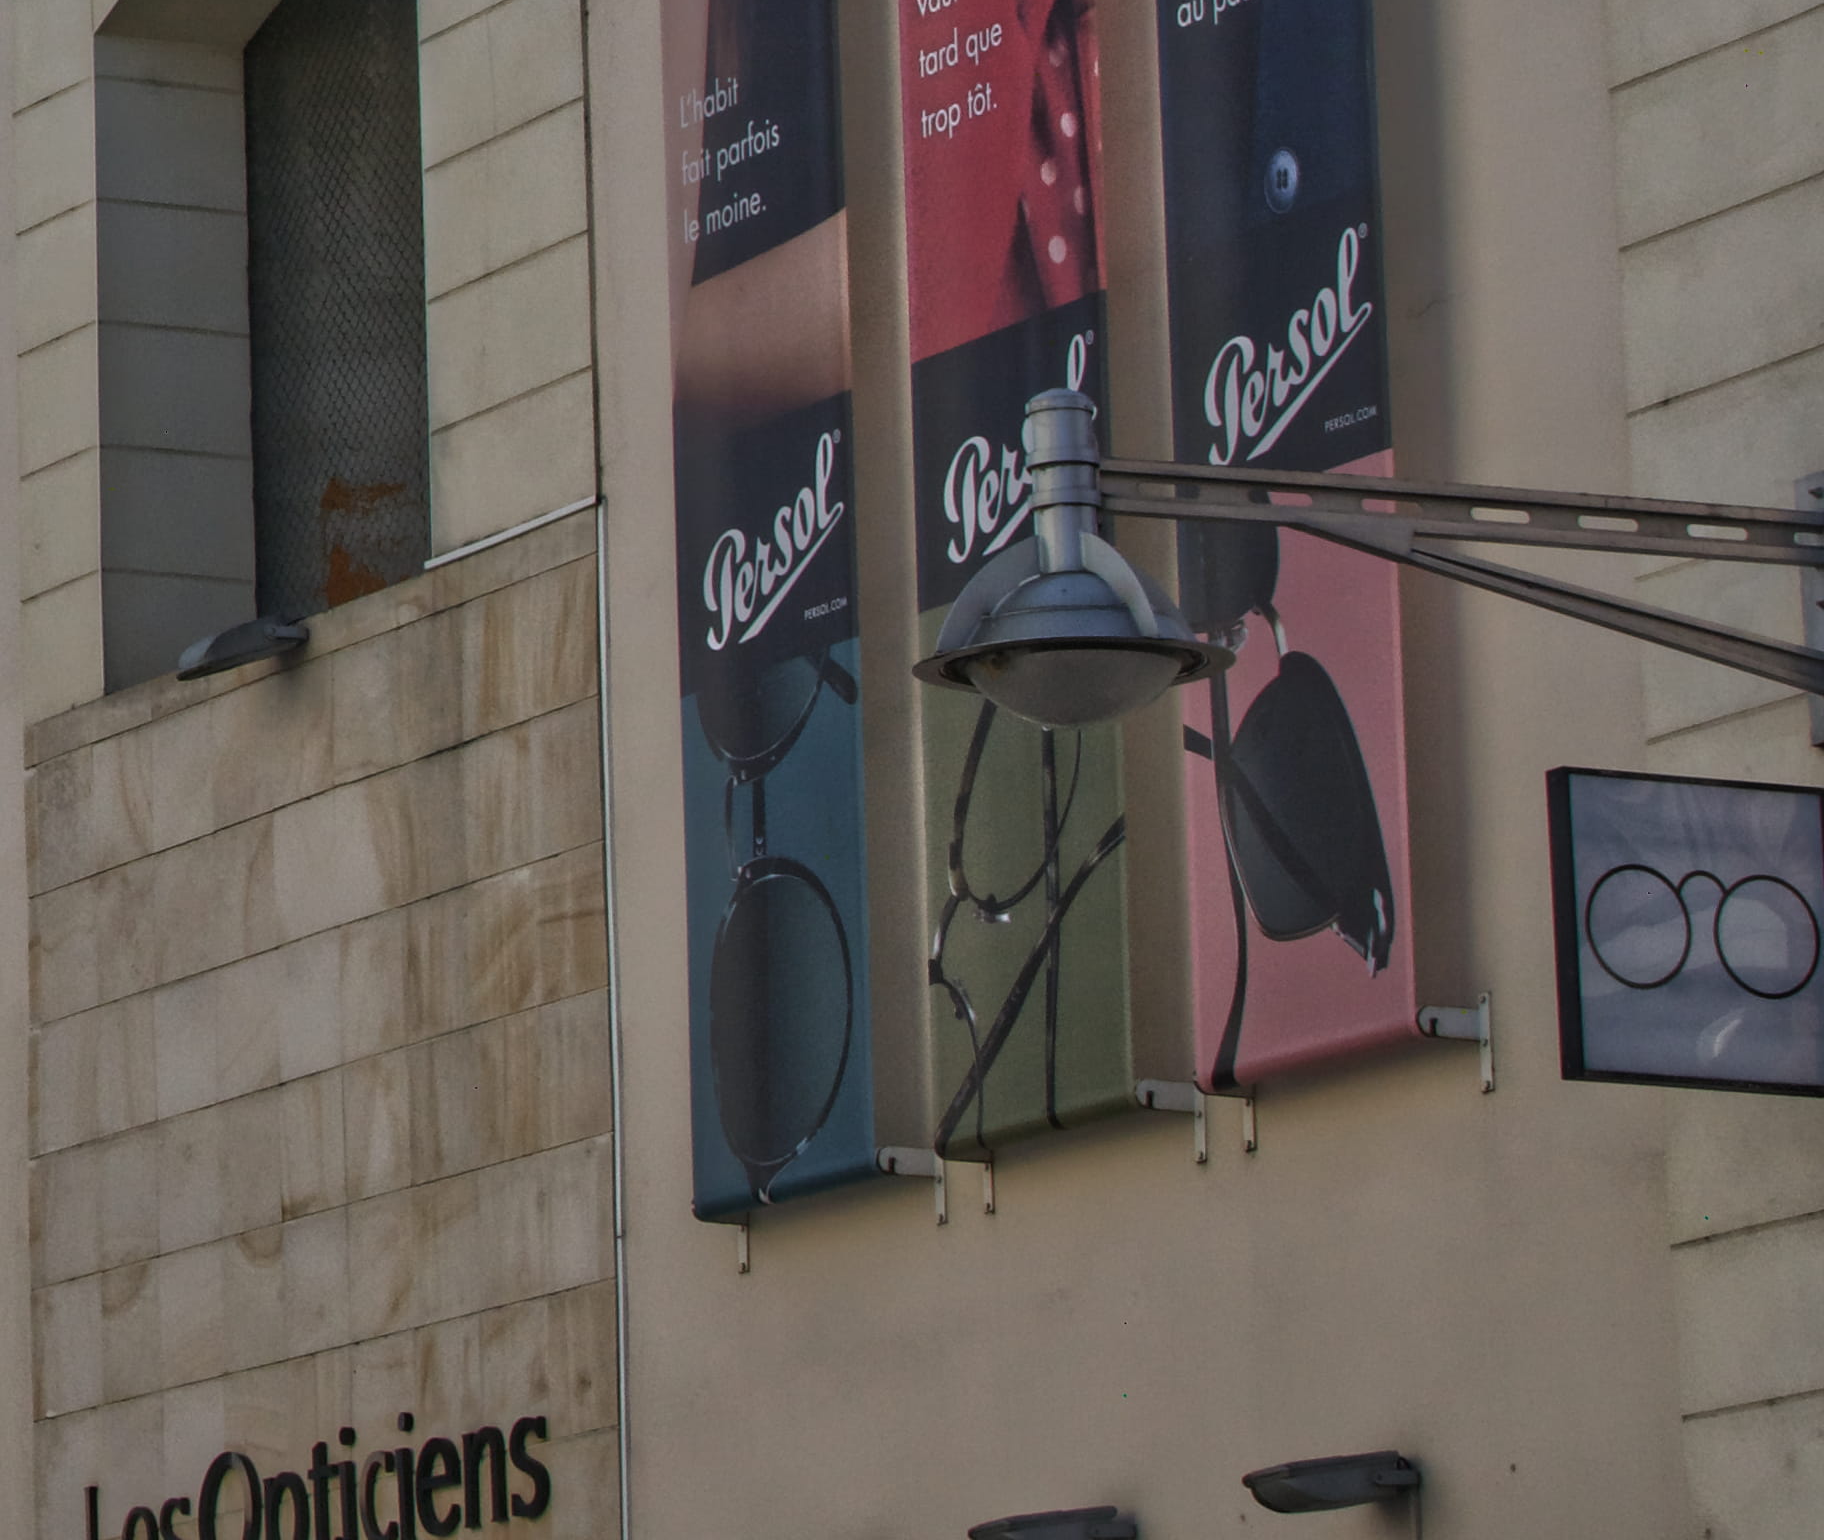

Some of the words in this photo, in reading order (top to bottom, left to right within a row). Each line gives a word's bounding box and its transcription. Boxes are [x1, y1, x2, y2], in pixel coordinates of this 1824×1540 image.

[918, 27, 958, 78] tard
[965, 23, 1003, 66] que
[680, 76, 739, 128] L'habit
[921, 102, 961, 139] trop
[967, 81, 998, 119] tôt.
[682, 147, 711, 186] fait
[716, 119, 780, 182] parfois
[684, 209, 700, 244] le
[706, 192, 767, 235] moine.
[1204, 227, 1373, 466] Persol
[1324, 405, 1377, 433] PERSOL.COM
[944, 334, 1097, 563] Perl
[703, 432, 844, 651] Persol
